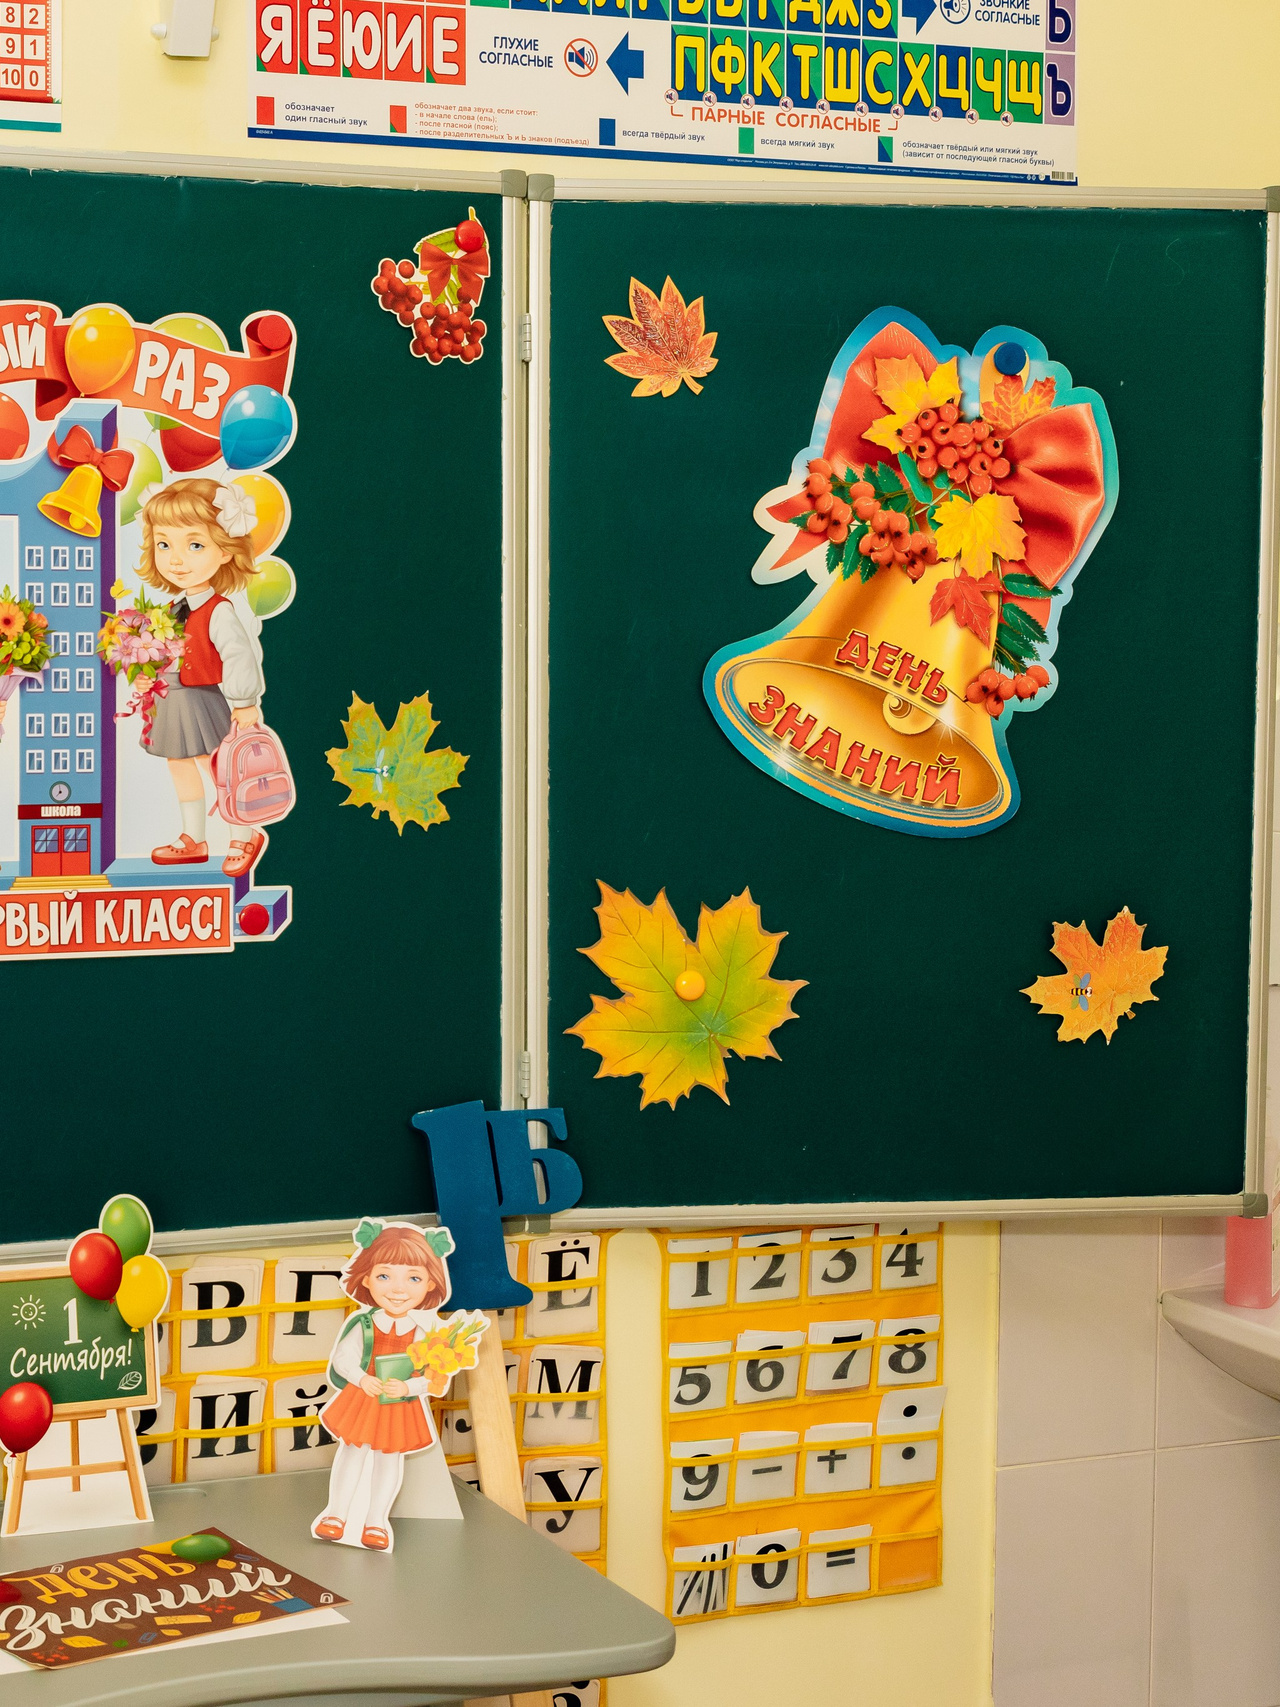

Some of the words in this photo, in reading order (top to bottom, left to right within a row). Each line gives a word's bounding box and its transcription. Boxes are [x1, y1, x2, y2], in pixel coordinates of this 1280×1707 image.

[975, 10, 1040, 26] СОГЛАСНЫЕ
[493, 36, 539, 51] ГЛУХИЕ
[479, 51, 553, 69] СОГЛАСНЫЕ
[284, 102, 335, 113] обозначает
[414, 102, 457, 111] обозначает
[473, 107, 495, 115] звука,
[425, 112, 452, 120] начале
[285, 114, 307, 124] один
[310, 115, 346, 125] гласный
[348, 119, 368, 127] звук
[419, 120, 441, 128] после
[443, 121, 473, 130] гласной
[691, 106, 765, 126] ПАРНЫЕ
[775, 113, 881, 133] СОГЛАСНЫЕ
[443, 130, 505, 141] разделительных
[554, 136, 590, 146] (подъезд)
[622, 129, 649, 139] всегда
[650, 130, 686, 141] твёрдый
[687, 133, 705, 142] звук
[760, 137, 787, 147] всегда
[788, 138, 816, 148] мягкий
[818, 141, 835, 150] звук
[902, 140, 944, 150] обозначает
[946, 142, 978, 153] твёрдый
[980, 145, 994, 153] или
[995, 146, 1021, 156] мягкий
[1022, 148, 1038, 157] звук
[902, 150, 934, 160] (зависит
[946, 152, 997, 163] последующей
[999, 155, 1028, 165] гласной
[1029, 156, 1055, 167] буквы)
[133, 340, 231, 420] РАЗ
[835, 628, 949, 705] ДЕНЬ
[748, 684, 962, 807] ЗНАНИЙ
[95, 896, 223, 945] КЛАСС!
[691, 1250, 713, 1298] 1
[749, 1241, 787, 1291] 2
[821, 1235, 858, 1284] 3
[885, 1227, 925, 1278] 4
[188, 1280, 247, 1348] В
[539, 1239, 592, 1313] Ё
[63, 1298, 83, 1346] 1
[9, 1336, 133, 1381] Сентября!
[673, 1364, 712, 1406] 5
[745, 1344, 785, 1393] 6
[831, 1331, 863, 1380] 7
[887, 1327, 927, 1375] 8
[191, 1390, 258, 1459] И
[528, 1358, 601, 1420] М
[682, 1453, 720, 1502] 9
[750, 1542, 789, 1590] 0
